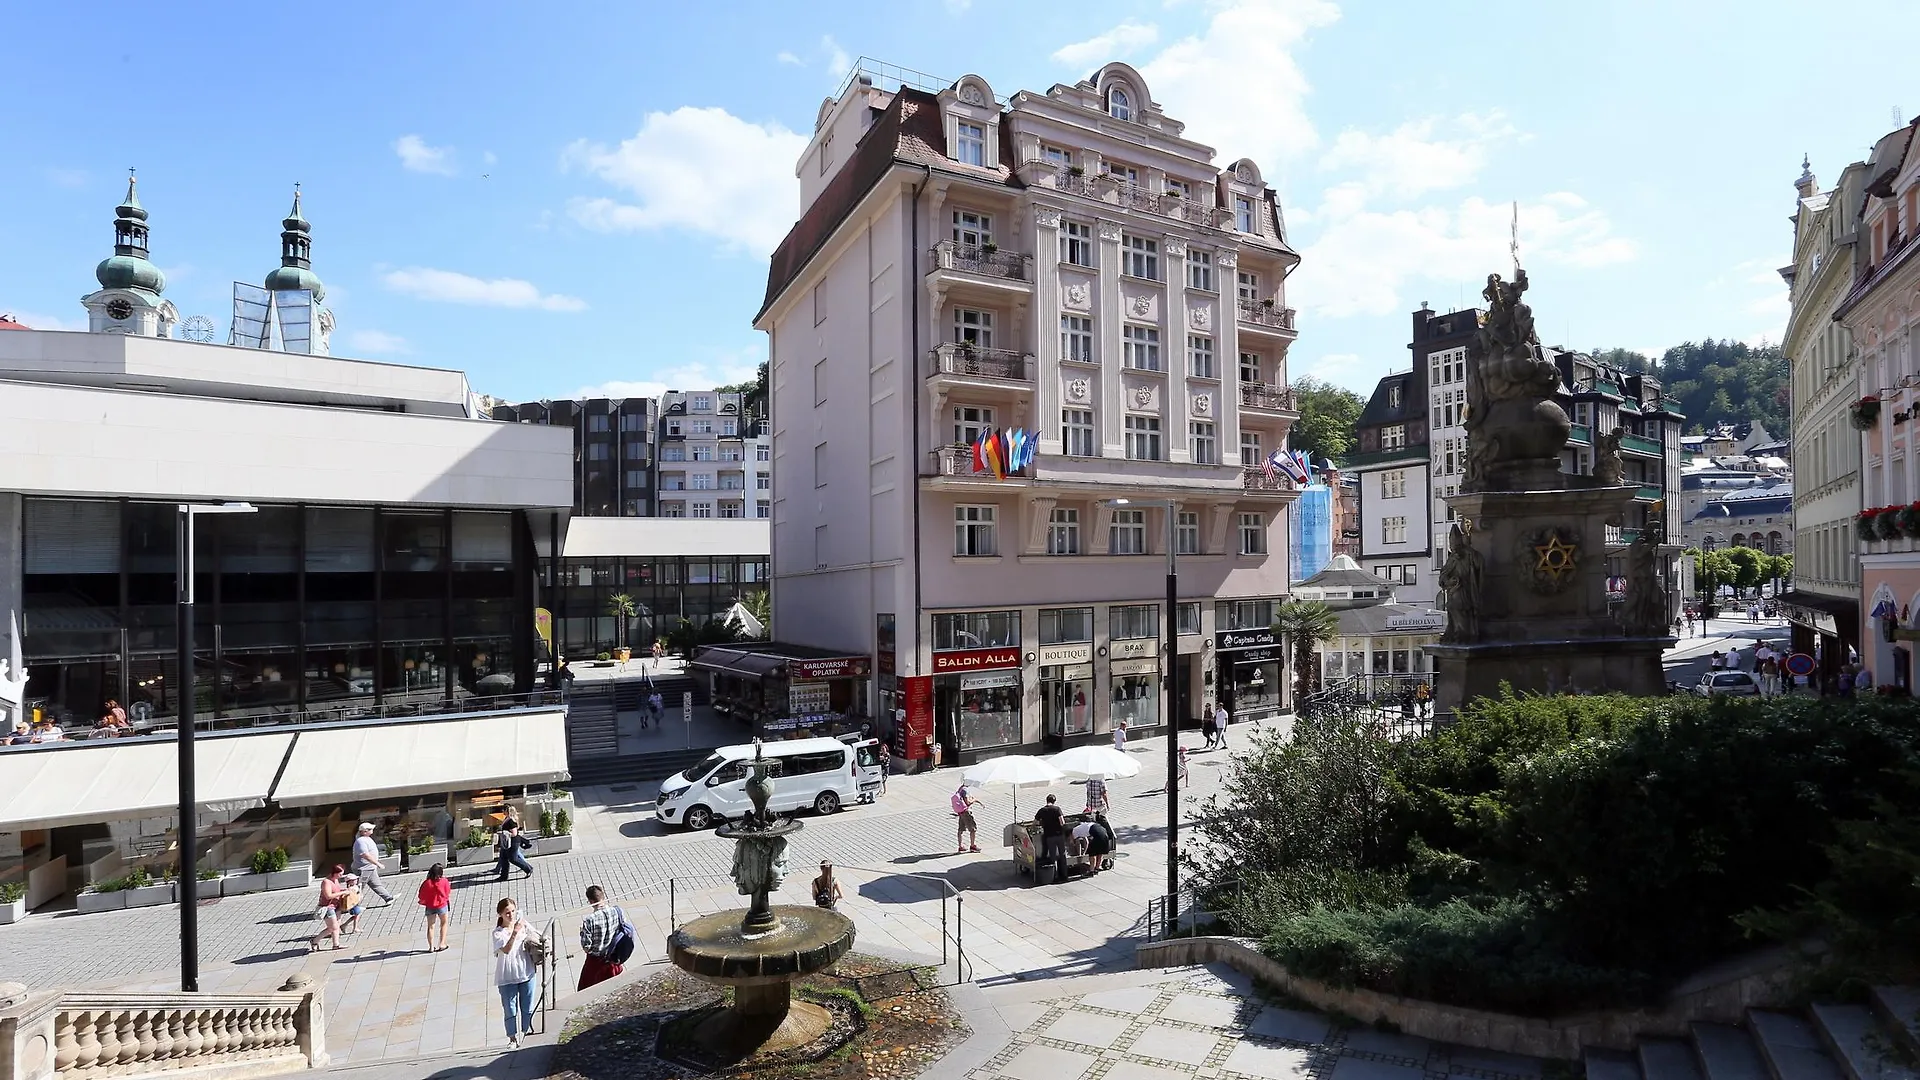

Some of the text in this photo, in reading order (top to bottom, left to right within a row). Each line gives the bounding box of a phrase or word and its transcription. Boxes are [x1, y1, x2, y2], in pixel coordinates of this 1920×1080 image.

[1256, 634, 1274, 643] Candy
[1124, 644, 1144, 652] BRAX
[1044, 648, 1087, 660] BOUTIQUE
[803, 660, 849, 670] KARLOVARSKÉ
[938, 654, 1016, 667] SALON ALLA
[812, 668, 840, 677] OPLATKY
